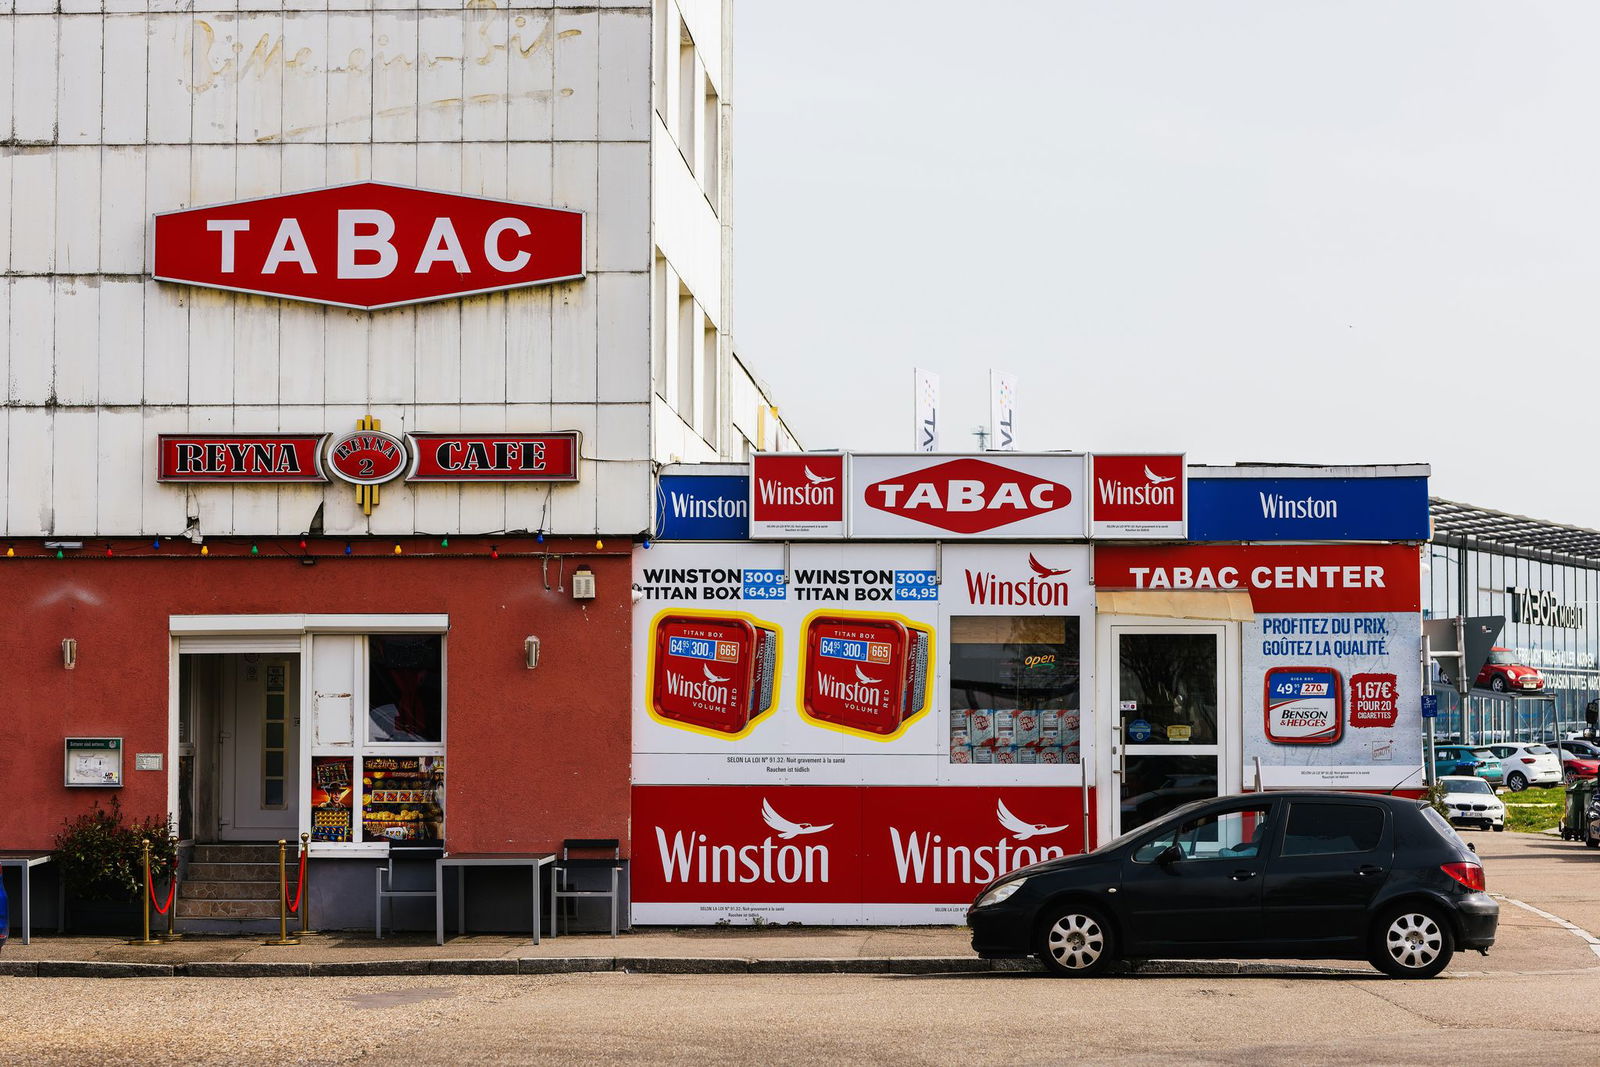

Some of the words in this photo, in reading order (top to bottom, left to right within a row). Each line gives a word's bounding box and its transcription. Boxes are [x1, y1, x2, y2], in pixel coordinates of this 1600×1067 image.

[206, 209, 532, 280] TABAC
[176, 443, 301, 473] REYNA
[336, 437, 398, 460] REYNA
[435, 440, 547, 472] CAFE
[359, 459, 374, 476] 2
[758, 478, 834, 505] Winston
[878, 480, 1054, 512] TABAC
[1098, 477, 1174, 506] Winston
[671, 491, 747, 518] Winston
[1260, 491, 1338, 518] Winston
[643, 569, 742, 584] WINSTON
[745, 572, 774, 583] 300
[776, 574, 784, 585] g
[794, 570, 893, 584] WINSTON
[896, 573, 926, 584] 300
[928, 575, 936, 586] g
[1129, 566, 1239, 590] TABAC
[1250, 566, 1386, 588] CENTER
[643, 587, 700, 600] TITAN
[703, 587, 742, 600] BOX
[744, 586, 785, 599] €64,95
[794, 588, 849, 600] TITAN
[855, 588, 893, 600] BOX
[964, 568, 1068, 606] Winston
[1510, 586, 1559, 628] TABOR
[1263, 618, 1328, 634] PROFITEZ
[1332, 618, 1350, 634] DU
[1354, 618, 1390, 636] PRIX,
[691, 641, 709, 656] 300
[720, 644, 737, 657] 665
[843, 642, 860, 658] 300
[872, 646, 888, 658] 665
[1262, 637, 1313, 656] GOÛTEZ
[1316, 640, 1332, 656] LA
[1333, 637, 1390, 658] QUALITÉ.
[1024, 653, 1056, 668] open
[666, 669, 728, 705] Winston
[818, 670, 880, 706] Winston
[1276, 684, 1293, 694] 49
[1356, 682, 1392, 700] 1,67€
[692, 701, 727, 714] VOLUME
[844, 702, 879, 714] VOLUME
[1282, 710, 1328, 719] BENSON
[1358, 701, 1380, 710] POUR
[1380, 701, 1392, 710] 20
[655, 826, 829, 884] Winston
[889, 826, 1064, 884] Winsto
